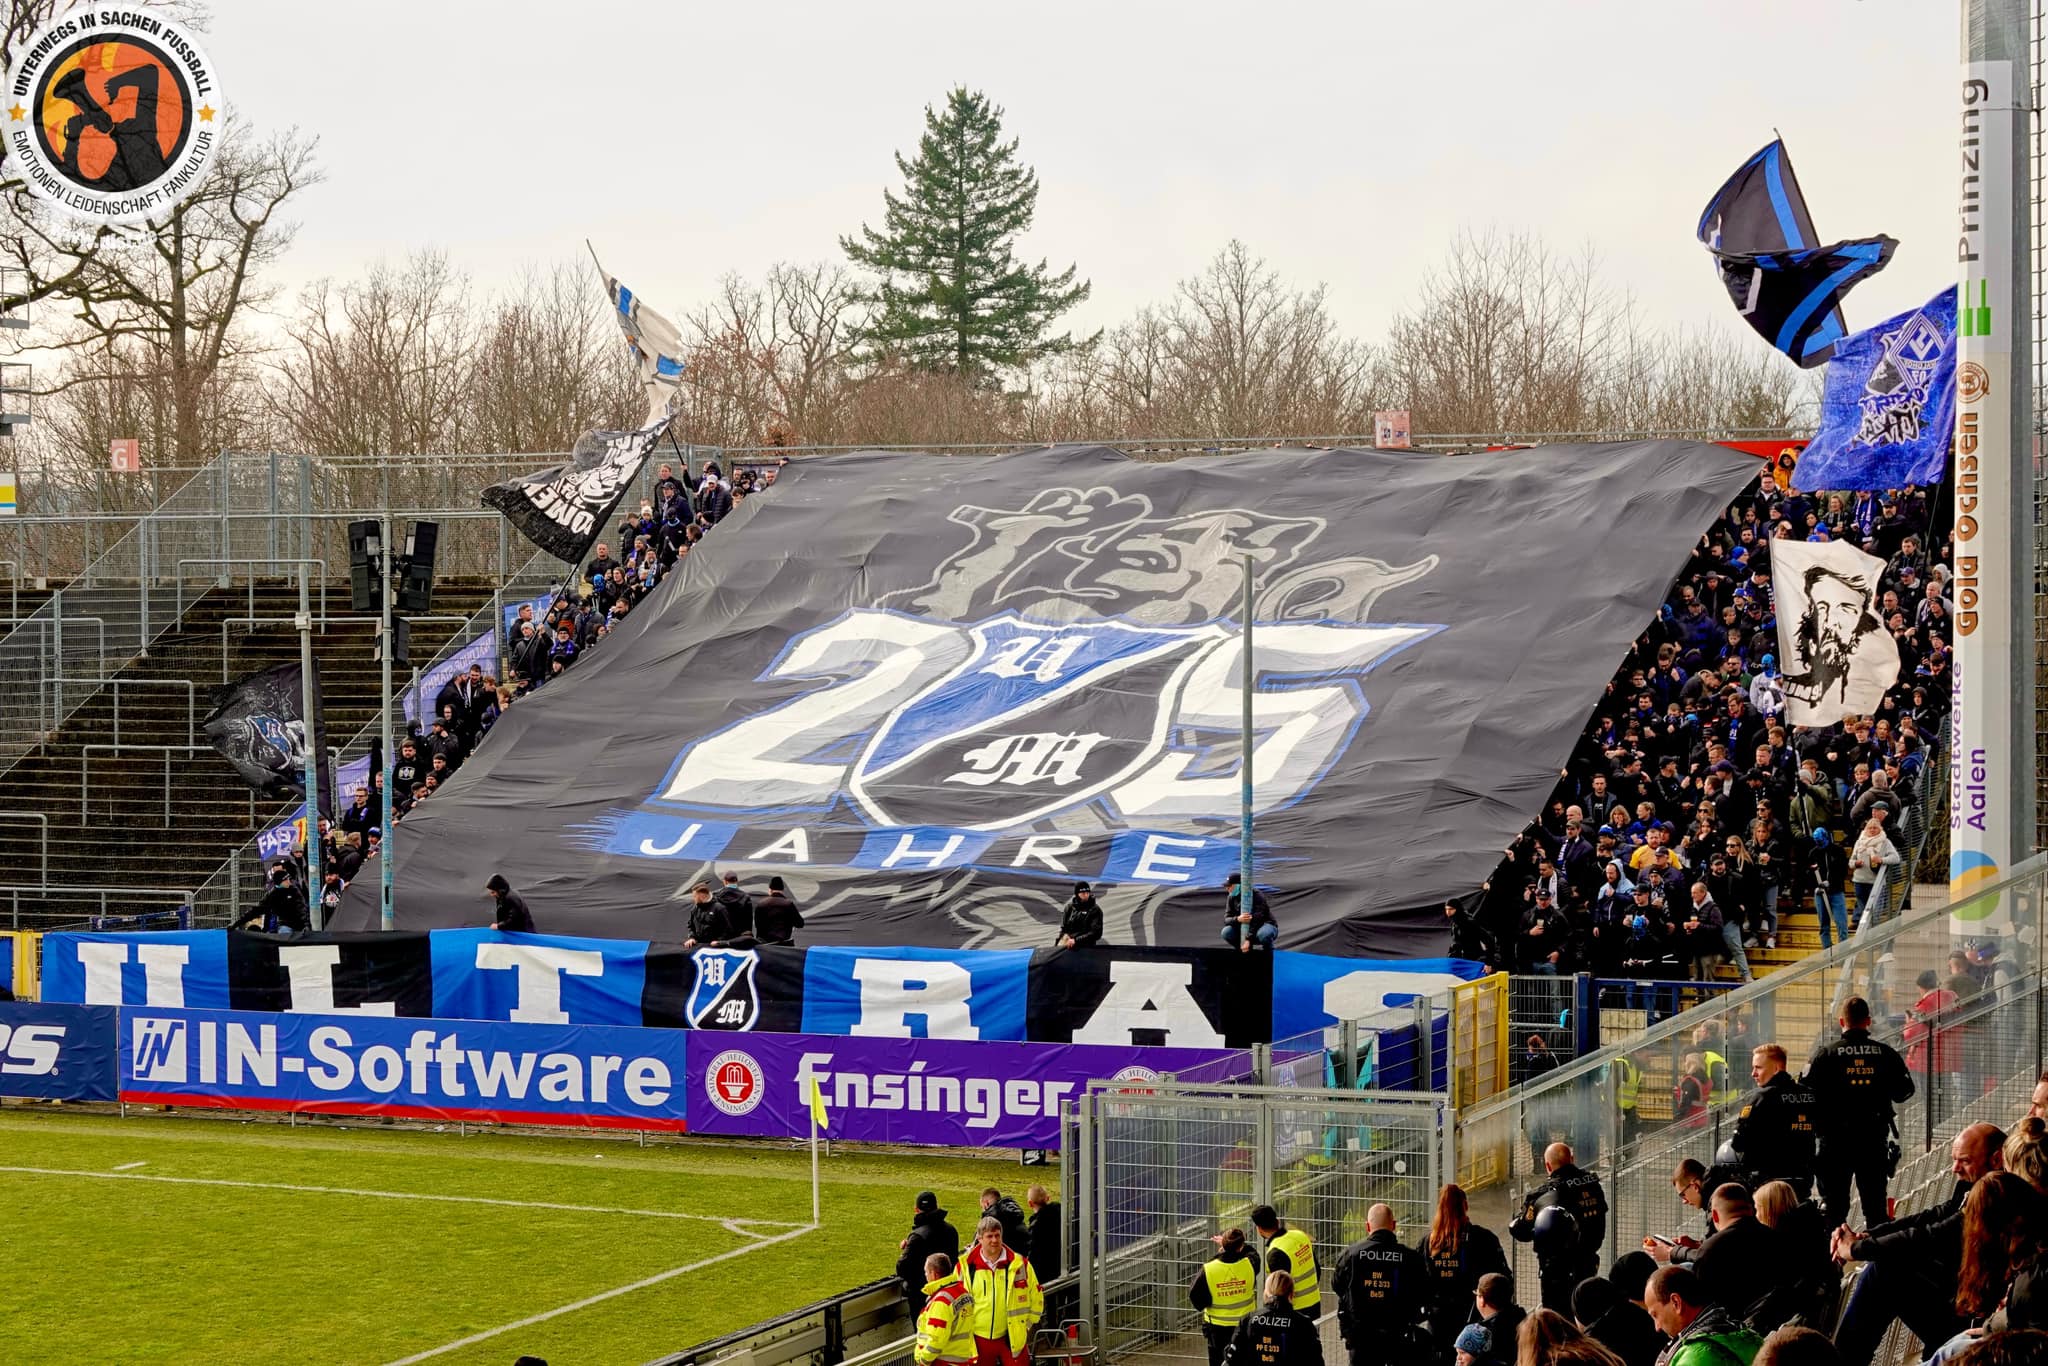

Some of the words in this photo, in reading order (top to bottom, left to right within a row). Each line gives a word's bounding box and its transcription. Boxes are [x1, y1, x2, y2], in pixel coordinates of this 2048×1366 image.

[1958, 78, 1989, 263] Prinzing
[112, 447, 128, 469] G
[1956, 412, 1979, 541] Ochsen
[1956, 556, 1979, 636] Gold
[1951, 661, 1962, 829] Stadtwerke
[1966, 748, 1986, 831] Aalen
[640, 822, 1206, 883] JAHRE
[199, 1021, 672, 1106] IN-Software
[1838, 1045, 1882, 1056] POLIZEI
[1781, 1093, 1817, 1104] POLIZE
[1360, 1250, 1403, 1263] POLIZEI
[1251, 1314, 1292, 1328] POLIZEI
